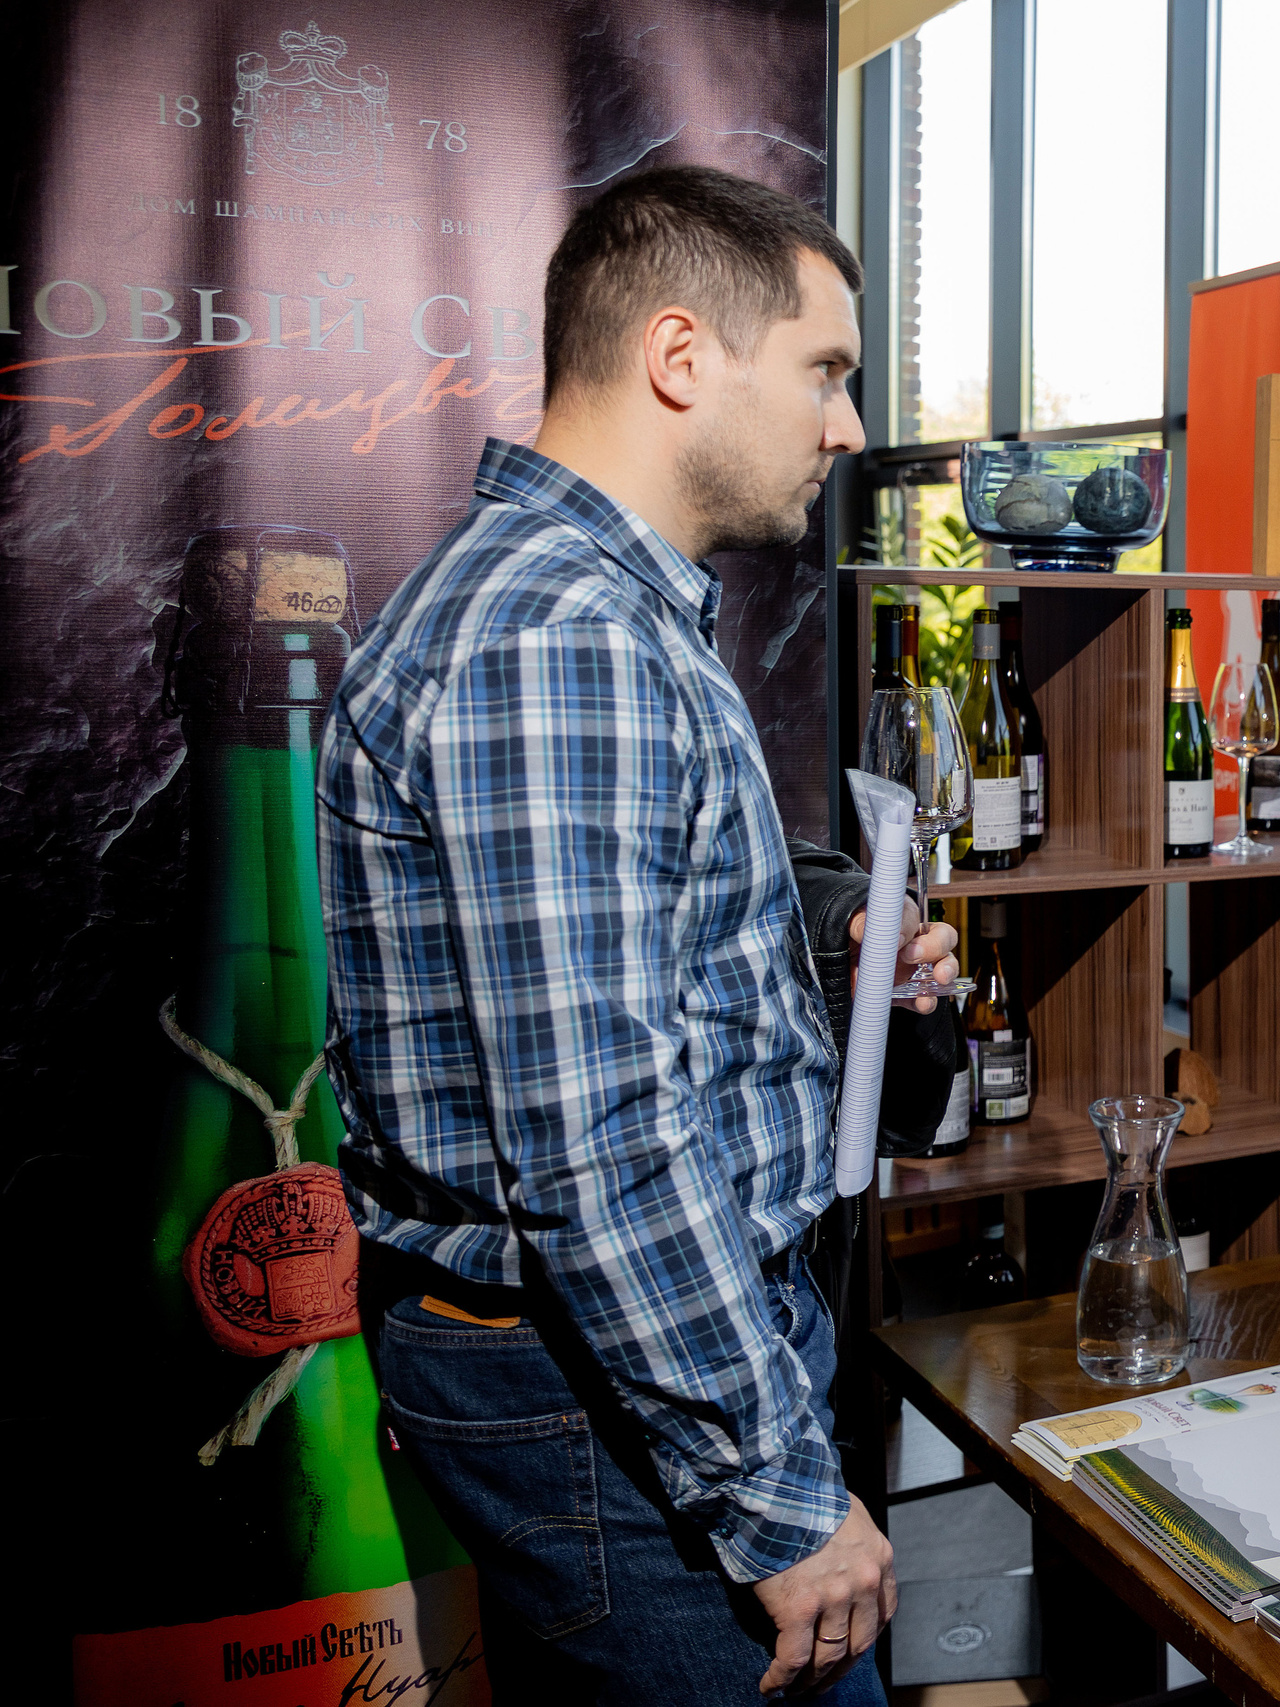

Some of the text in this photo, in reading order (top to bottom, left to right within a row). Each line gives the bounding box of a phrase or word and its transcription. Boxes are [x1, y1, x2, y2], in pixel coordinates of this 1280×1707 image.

[157, 94, 468, 153] 18 78
[215, 199, 424, 232] ШАМПАНСКИХ
[410, 294, 537, 361] СВ
[222, 1633, 317, 1683] Новый
